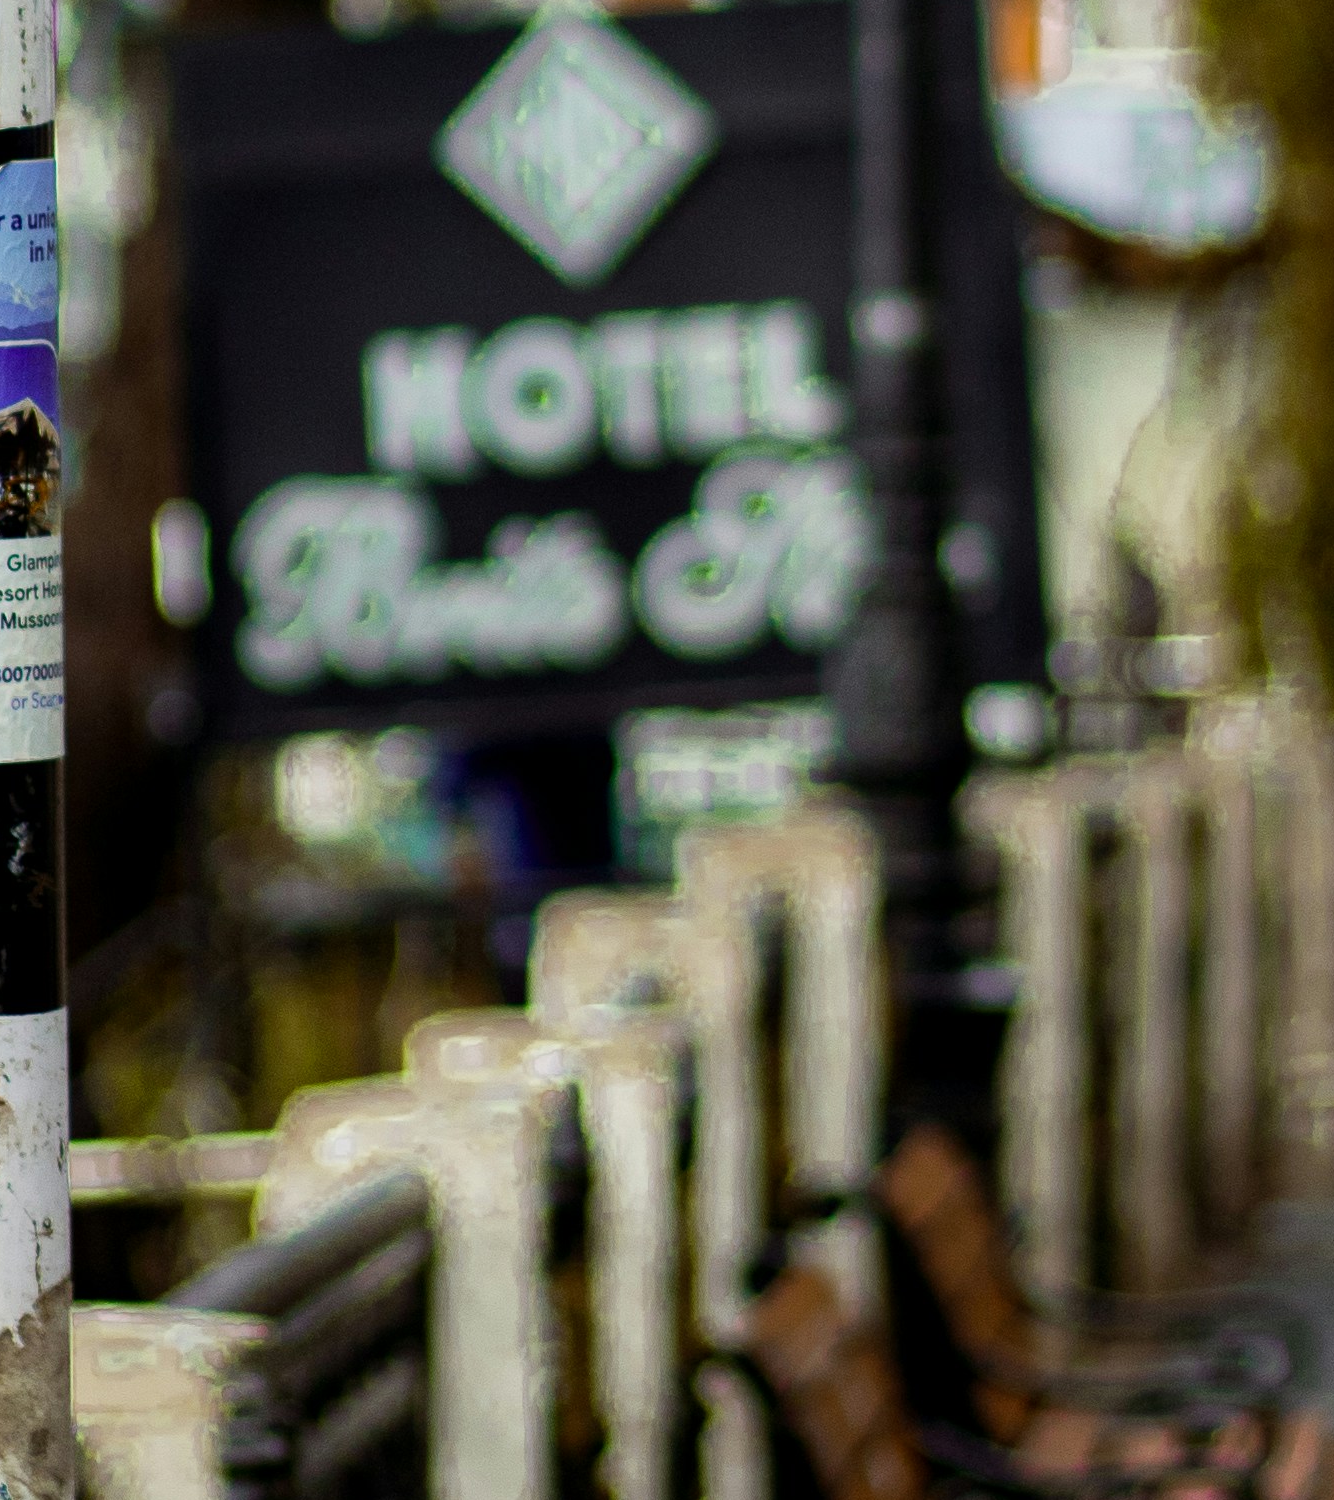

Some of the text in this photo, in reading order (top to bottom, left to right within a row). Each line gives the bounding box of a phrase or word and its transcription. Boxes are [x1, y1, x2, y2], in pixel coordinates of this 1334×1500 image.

[10, 214, 23, 231] a
[29, 240, 44, 263] in
[11, 696, 28, 712] or
